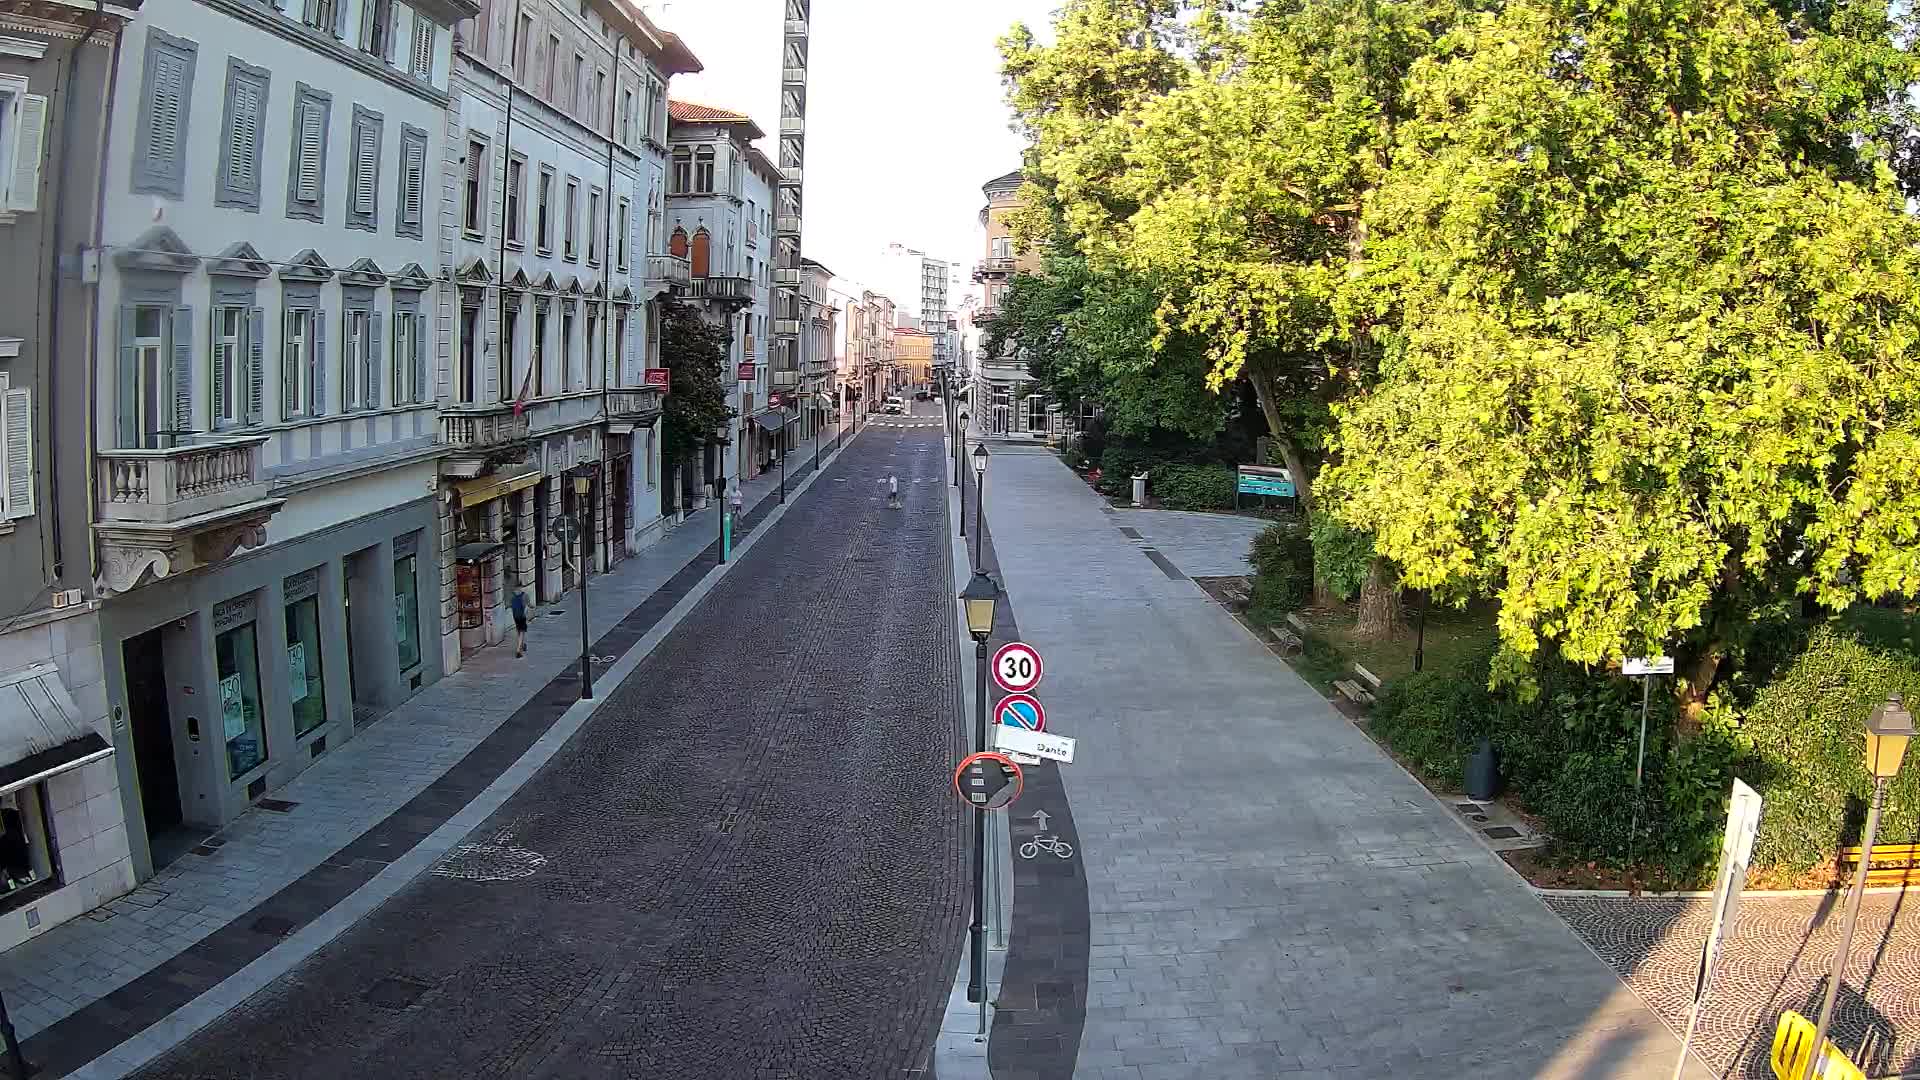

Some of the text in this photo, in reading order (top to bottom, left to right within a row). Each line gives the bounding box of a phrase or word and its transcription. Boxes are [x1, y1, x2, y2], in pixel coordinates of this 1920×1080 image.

[1004, 656, 1031, 679] 30
[220, 677, 239, 700] 130
[1037, 743, 1067, 756] Dante
